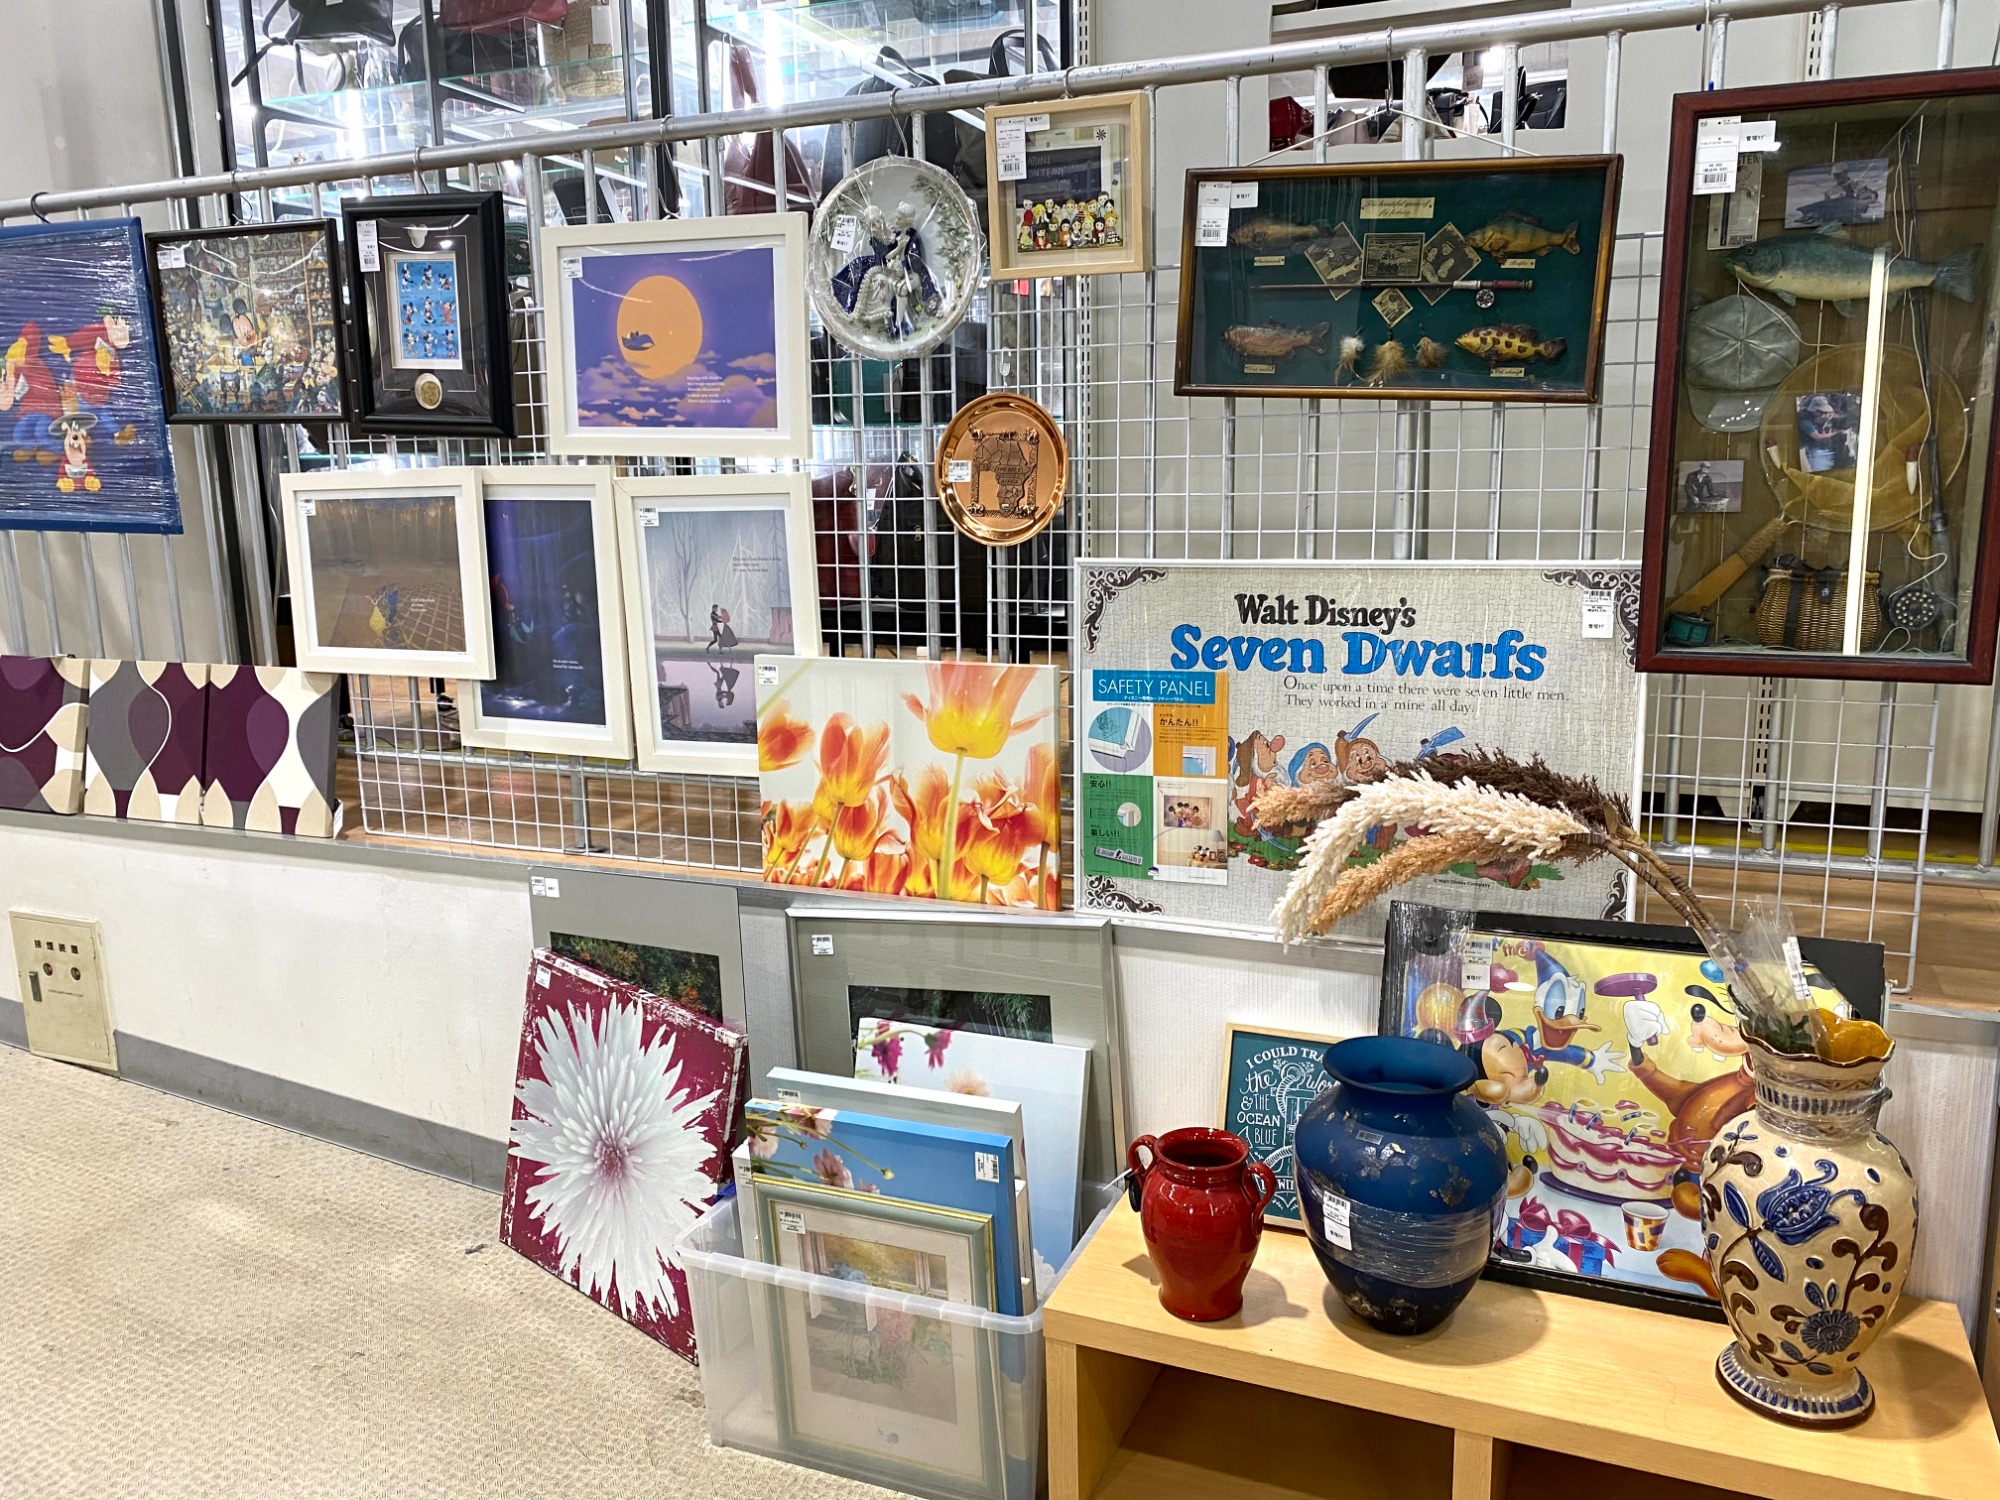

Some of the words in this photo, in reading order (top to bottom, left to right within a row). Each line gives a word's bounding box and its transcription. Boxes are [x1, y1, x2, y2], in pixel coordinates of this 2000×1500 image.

[1027, 155, 1051, 167] ARINI
[1234, 593, 1299, 625] Walt
[1304, 597, 1417, 635] Disney's
[1171, 623, 1327, 674] Seven
[1341, 629, 1547, 681] Dwarfs
[1098, 678, 1154, 695] SAFETY
[1160, 680, 1211, 697] PANEL
[1283, 675, 1318, 691] Once
[1322, 682, 1352, 697] upon
[1355, 684, 1362, 693] a
[1366, 683, 1395, 695] time
[1398, 683, 1430, 695] there
[1432, 686, 1462, 697] were
[1465, 687, 1499, 698] seven
[1502, 686, 1533, 699] little
[1537, 690, 1570, 702] men.
[1284, 693, 1315, 708] They
[1318, 696, 1362, 709] worked
[1365, 697, 1377, 709] in
[1380, 701, 1388, 710] a
[1394, 699, 1426, 711] mine
[1430, 699, 1446, 712] all
[1449, 701, 1475, 715] day.
[1246, 1058, 1255, 1070] I
[1253, 1046, 1298, 1065] COULD
[1301, 1047, 1325, 1065] TRA
[1239, 1069, 1277, 1095] the
[1240, 1094, 1254, 1112] &
[1253, 1093, 1271, 1111] THE
[1236, 1111, 1281, 1127] OCEAN
[1254, 1128, 1278, 1147] BLUE
